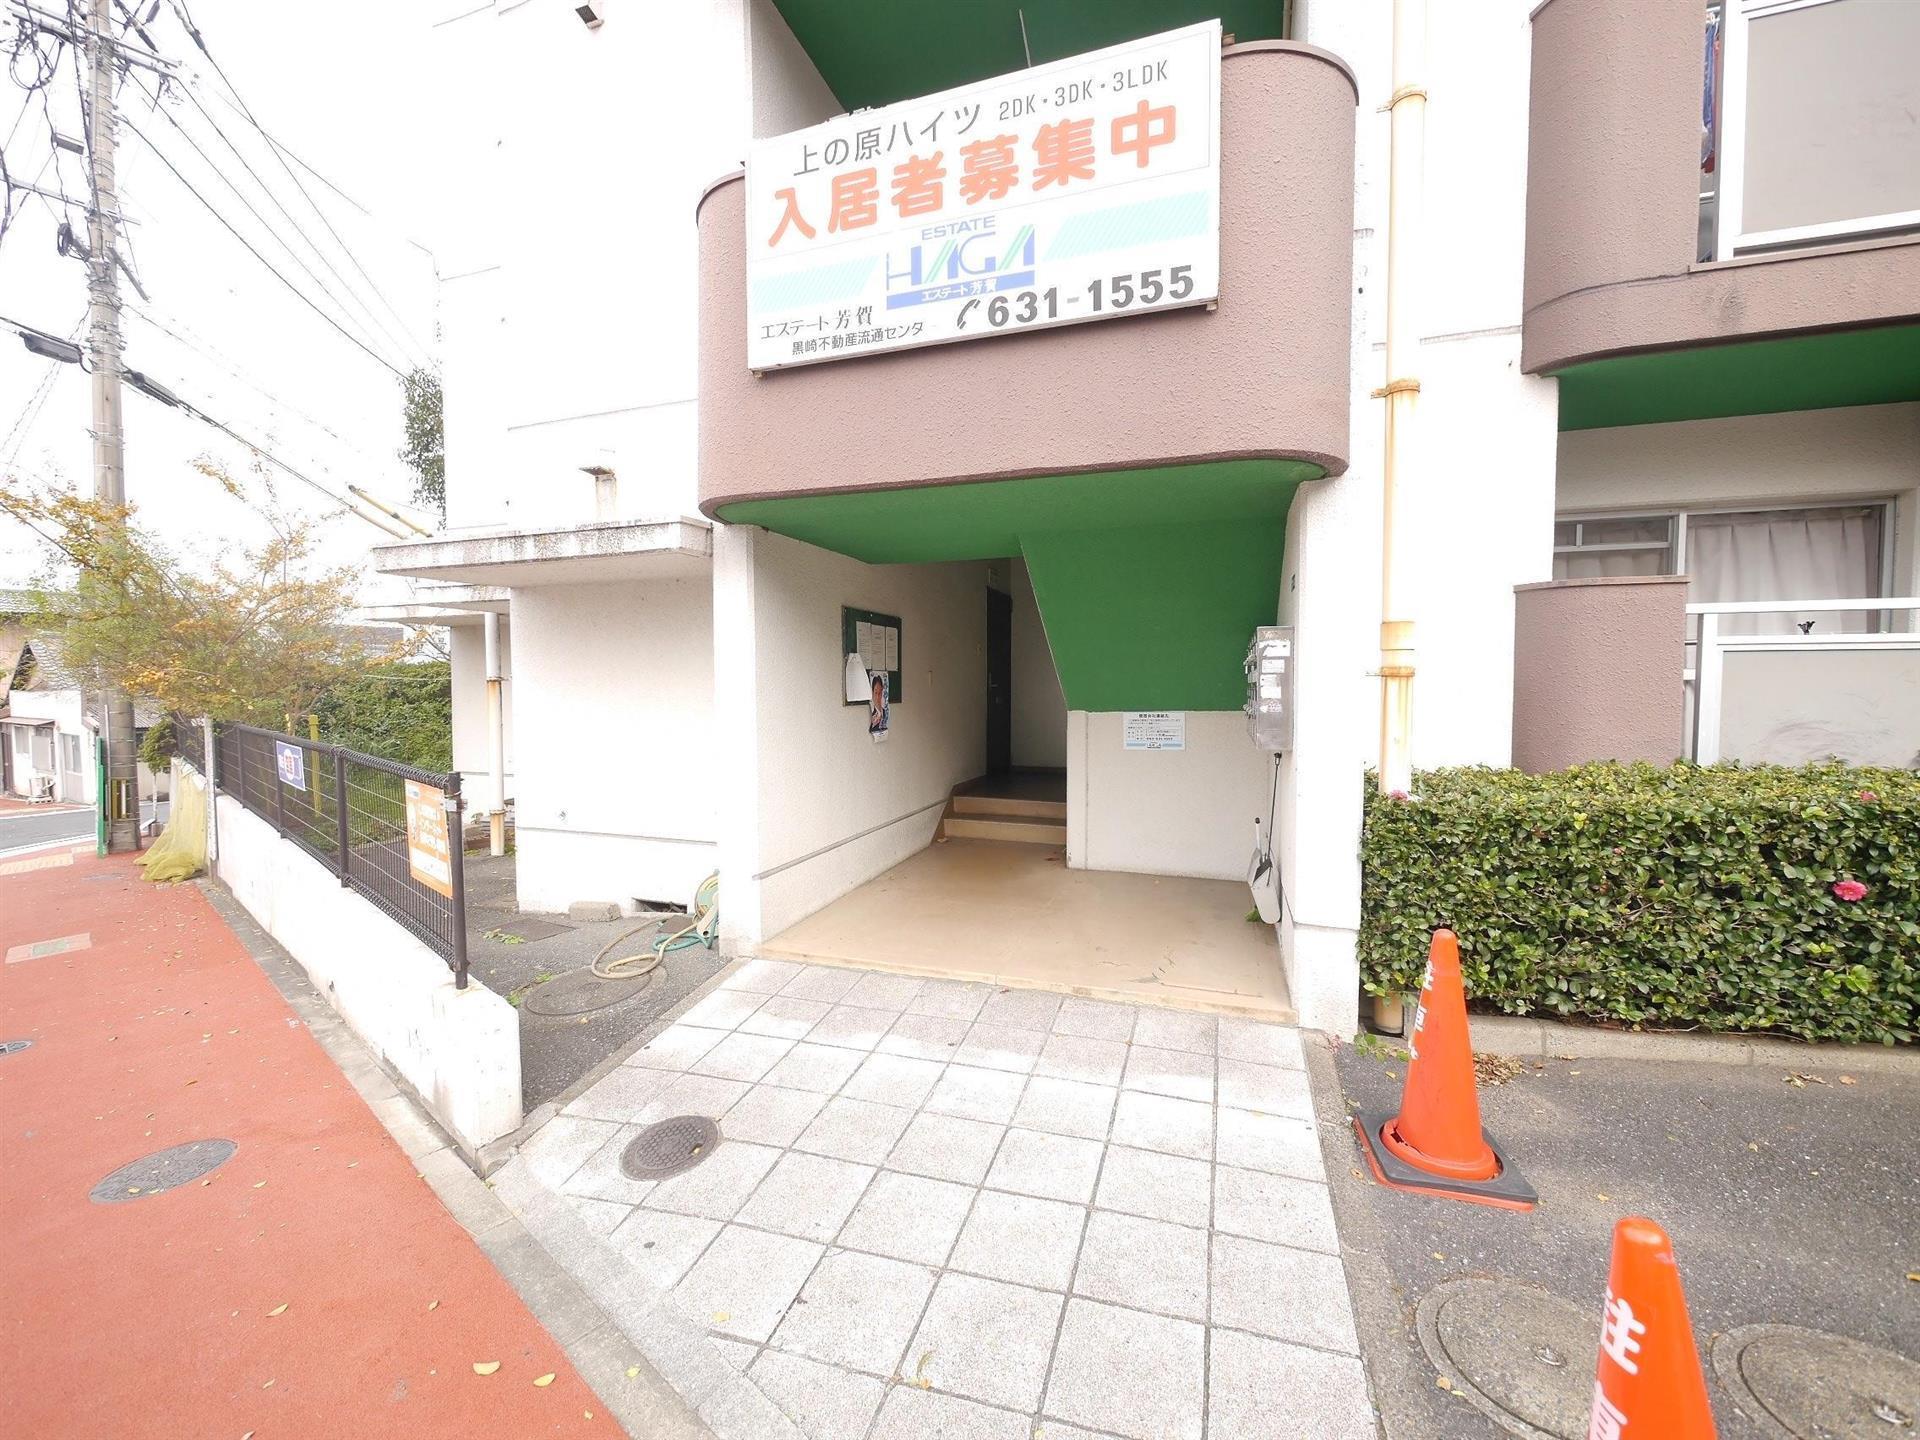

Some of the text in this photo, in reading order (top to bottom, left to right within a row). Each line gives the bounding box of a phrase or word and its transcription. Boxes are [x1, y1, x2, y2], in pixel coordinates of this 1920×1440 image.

[768, 98, 1177, 247] 入居者募集中
[793, 104, 981, 177] 上の原ハイツ
[920, 216, 996, 241] ESTATE
[987, 264, 1195, 328] 631-1555
